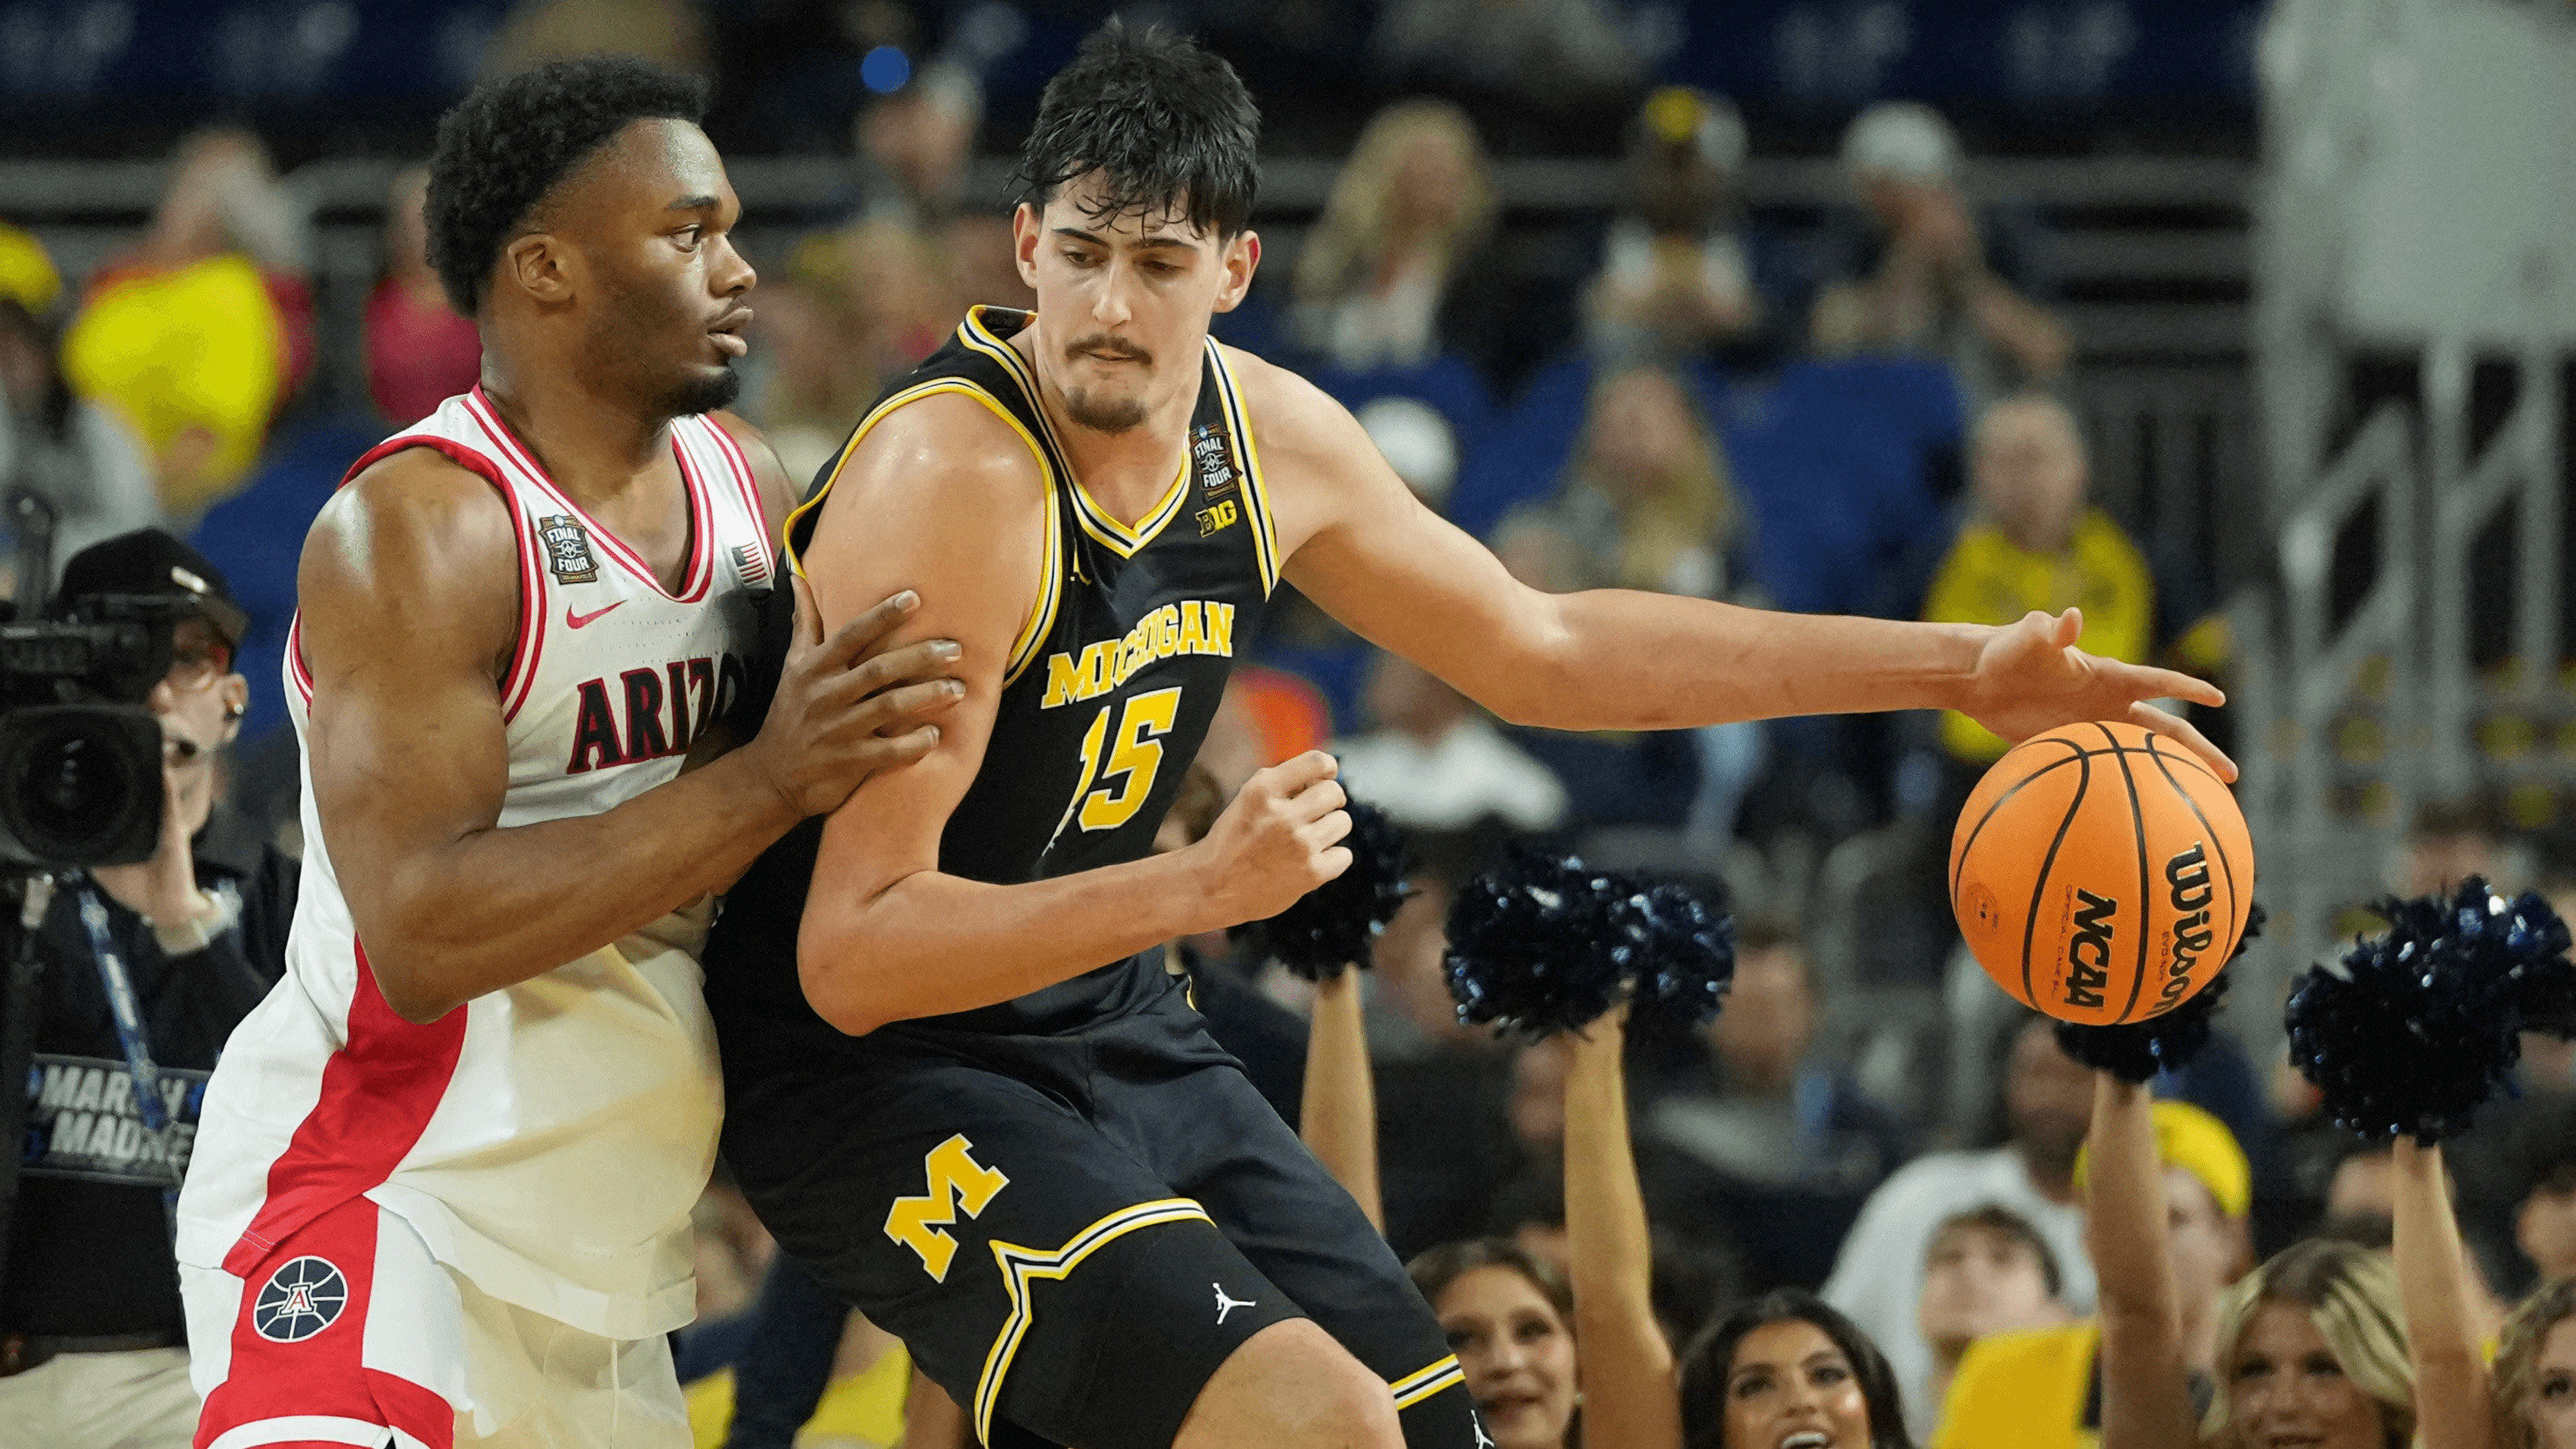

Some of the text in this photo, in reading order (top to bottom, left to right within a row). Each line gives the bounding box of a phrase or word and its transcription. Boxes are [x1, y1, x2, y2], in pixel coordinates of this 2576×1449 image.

[1194, 437, 1224, 459] FINAL
[1202, 466, 1233, 488] FOUR
[546, 527, 582, 543] FINAL
[557, 556, 590, 572] FOUR
[1040, 600, 1235, 710] MICHIGAN
[1042, 686, 1183, 855] 15
[2063, 886, 2118, 1009] NCAA
[2142, 839, 2214, 1016] Wilson
[40, 1064, 188, 1120] MARH
[883, 1132, 1011, 1284] M
[278, 1282, 318, 1319] A
